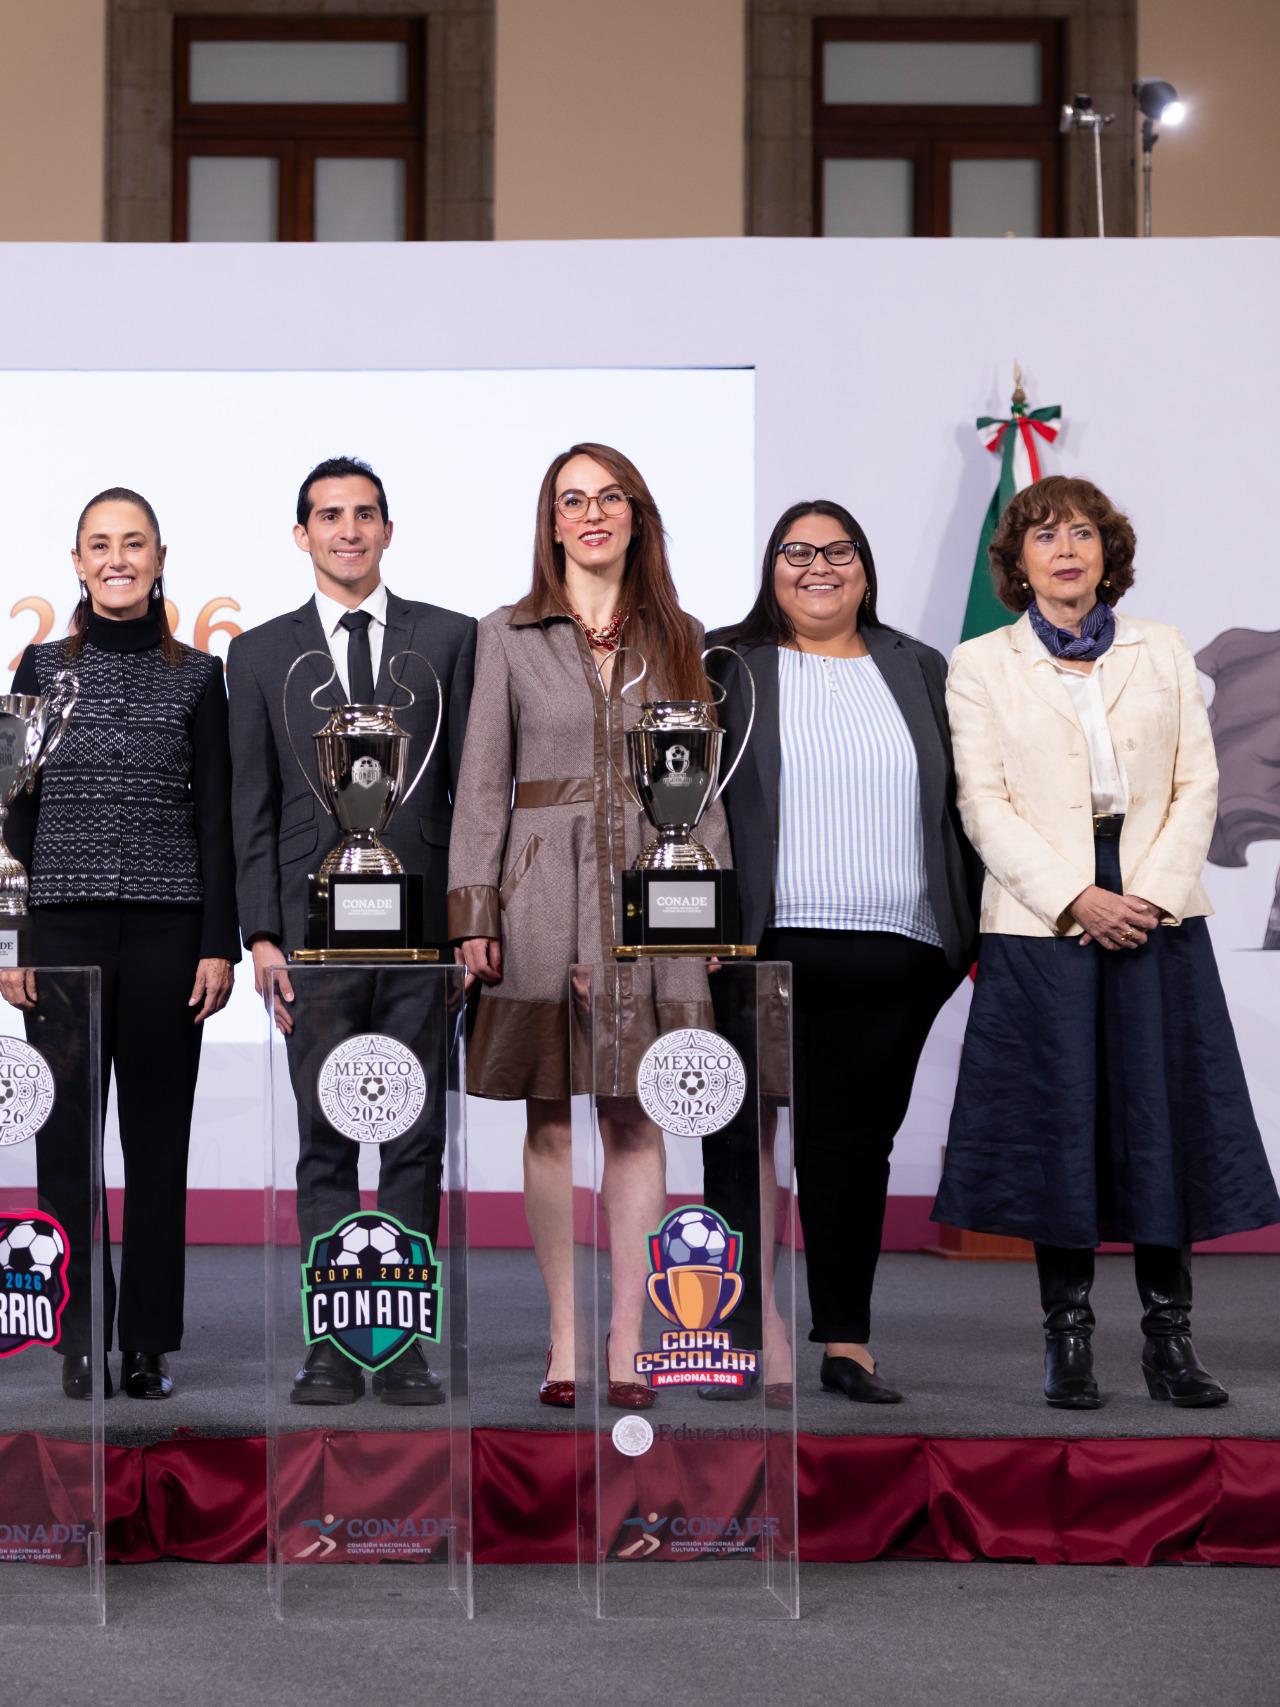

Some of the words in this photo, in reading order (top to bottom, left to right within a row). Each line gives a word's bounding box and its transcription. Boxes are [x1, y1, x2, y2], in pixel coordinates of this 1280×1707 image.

[342, 899, 393, 909] CONADE
[656, 896, 708, 906] CONADE
[334, 1061, 412, 1076] MEXICO
[653, 1055, 732, 1070] MEXICO
[350, 1105, 397, 1122] 2026
[669, 1100, 716, 1116] 2026
[6, 1272, 42, 1291] 2026
[315, 1267, 363, 1282] COPA
[380, 1267, 428, 1281] 2026
[312, 1290, 432, 1335] CONADE
[662, 1331, 730, 1350] COPA
[636, 1351, 756, 1372] ESCOLAR
[657, 1373, 712, 1384] NACIONAL
[713, 1373, 738, 1384] 2026
[657, 1423, 773, 1442] Educación
[346, 1518, 457, 1538] CONADE
[670, 1517, 781, 1537] CONADE
